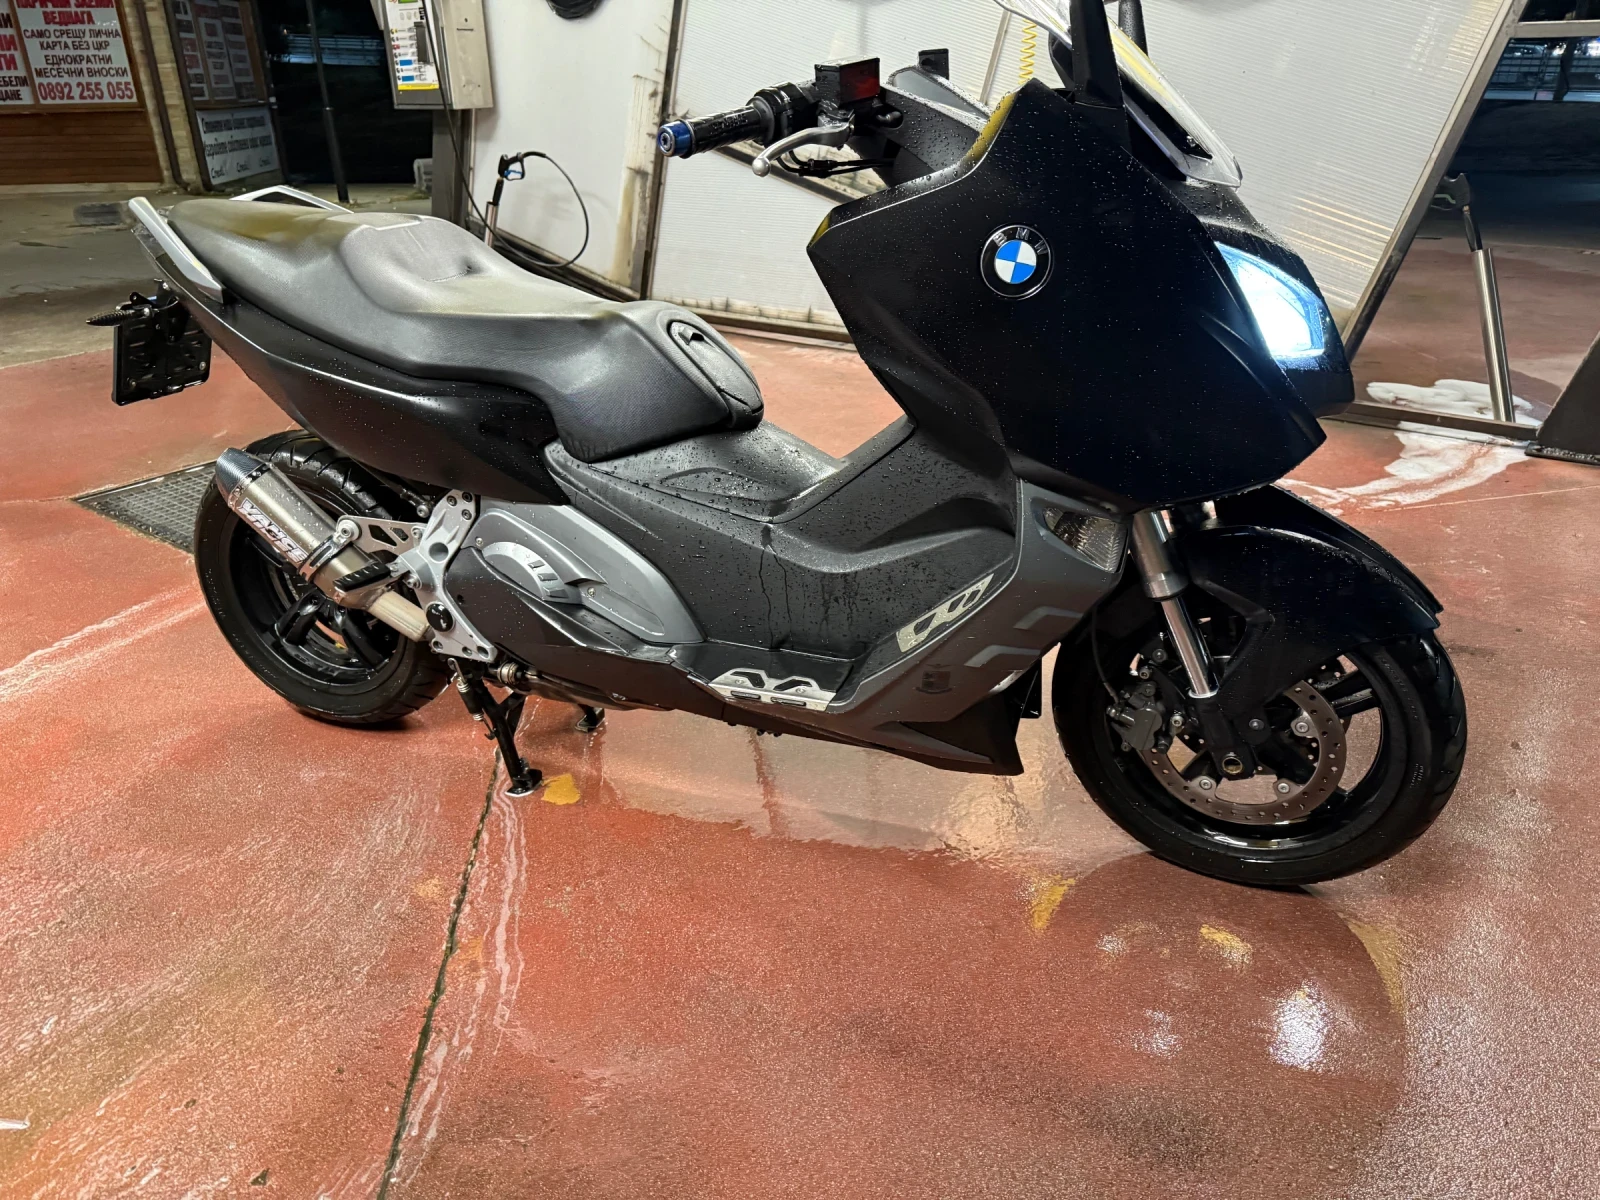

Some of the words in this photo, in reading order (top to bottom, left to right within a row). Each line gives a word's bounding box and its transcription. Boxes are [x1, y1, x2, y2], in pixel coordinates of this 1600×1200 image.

[23, 29, 51, 39] САМО
[54, 29, 86, 39] СРЕЩУ
[89, 29, 121, 39] ЛИЧНА
[40, 41, 70, 51] КАРТА
[72, 41, 90, 50] БЕЗ
[92, 41, 110, 52] ЦКР
[44, 54, 113, 66] ЕДНОКРАТНИ
[34, 67, 84, 78] МЕСЕЧНИ
[86, 67, 128, 78] ВНОСКИ
[38, 82, 74, 100] 0892
[76, 82, 104, 100] 255
[107, 81, 134, 99] 055
[992, 227, 1048, 255] BMW
